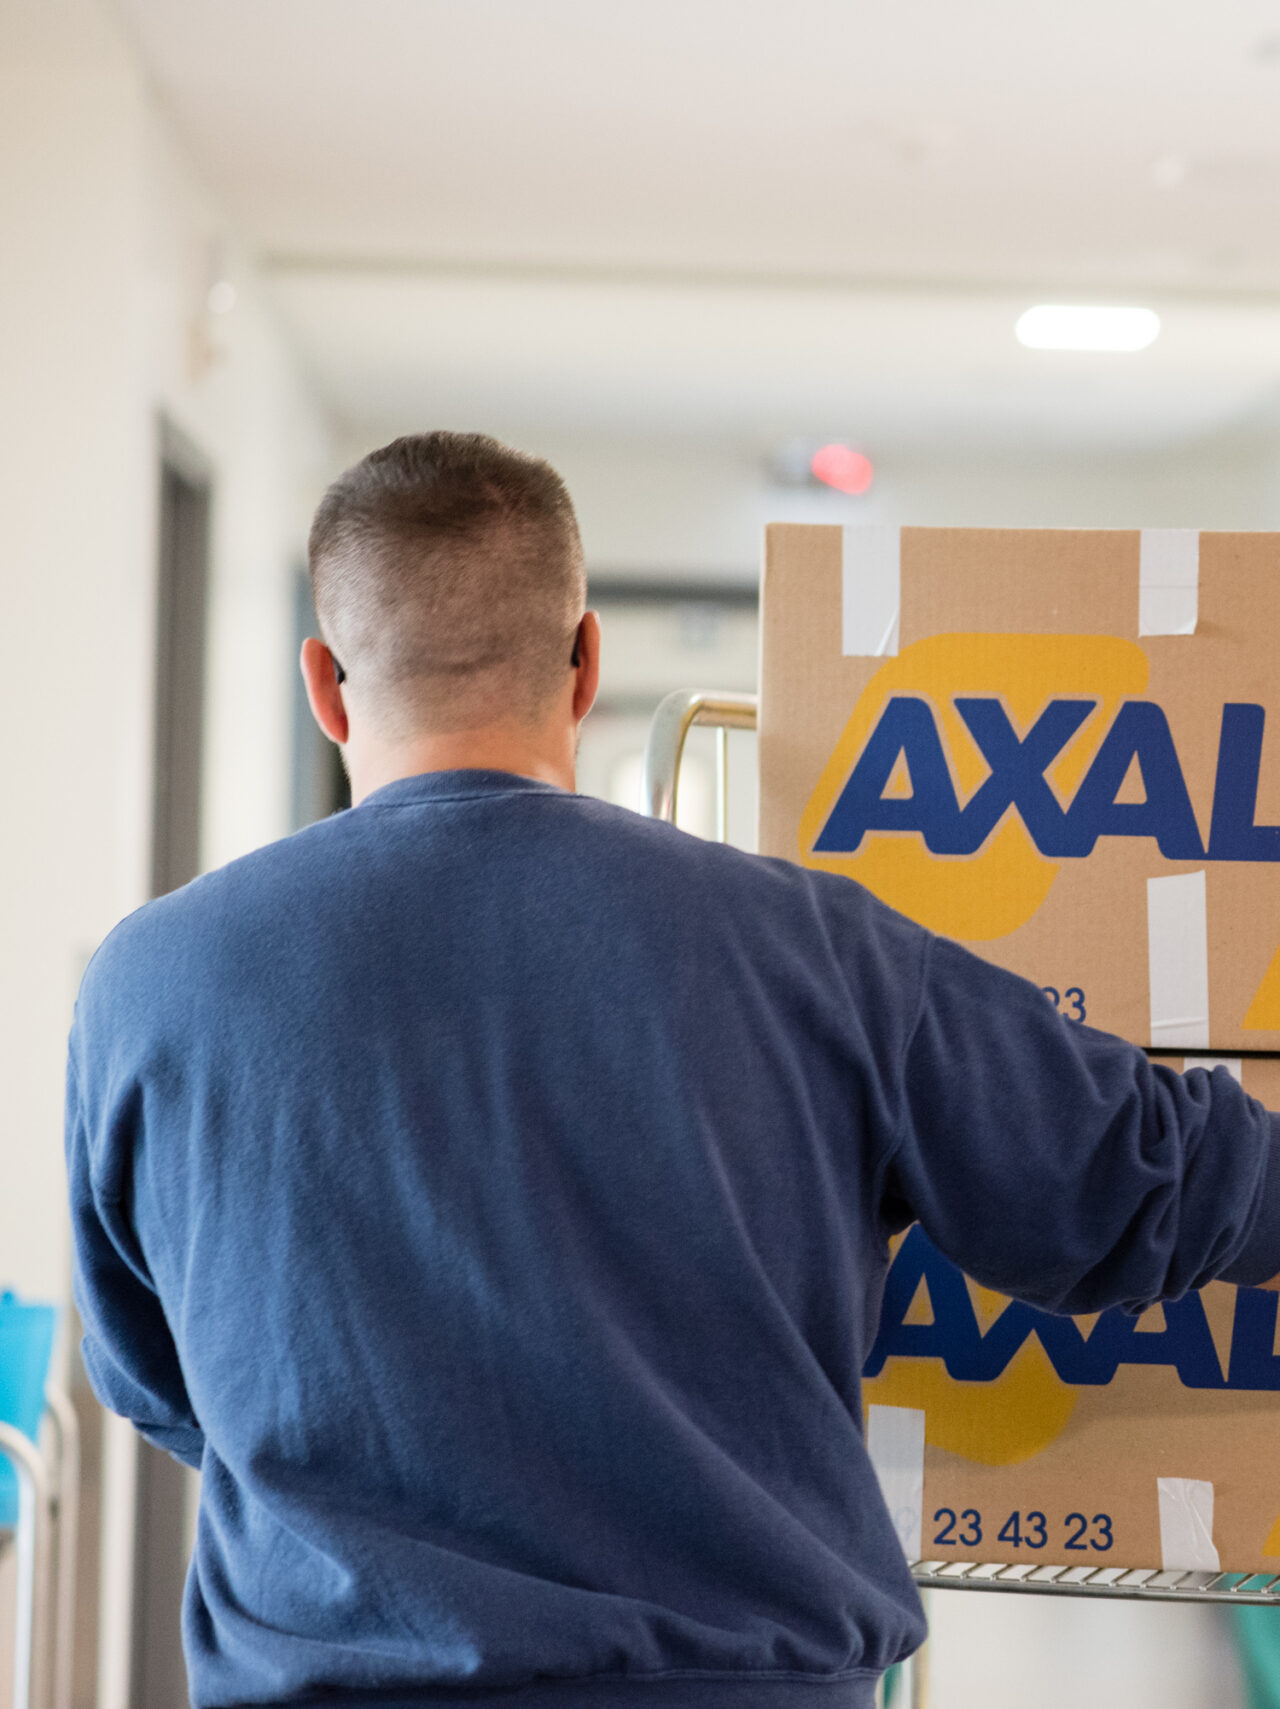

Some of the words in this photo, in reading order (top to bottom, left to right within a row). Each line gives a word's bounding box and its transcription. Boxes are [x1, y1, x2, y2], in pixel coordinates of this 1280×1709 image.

[933, 1507, 983, 1547] 23
[997, 1510, 1049, 1549] 43
[1064, 1512, 1115, 1552] 23
